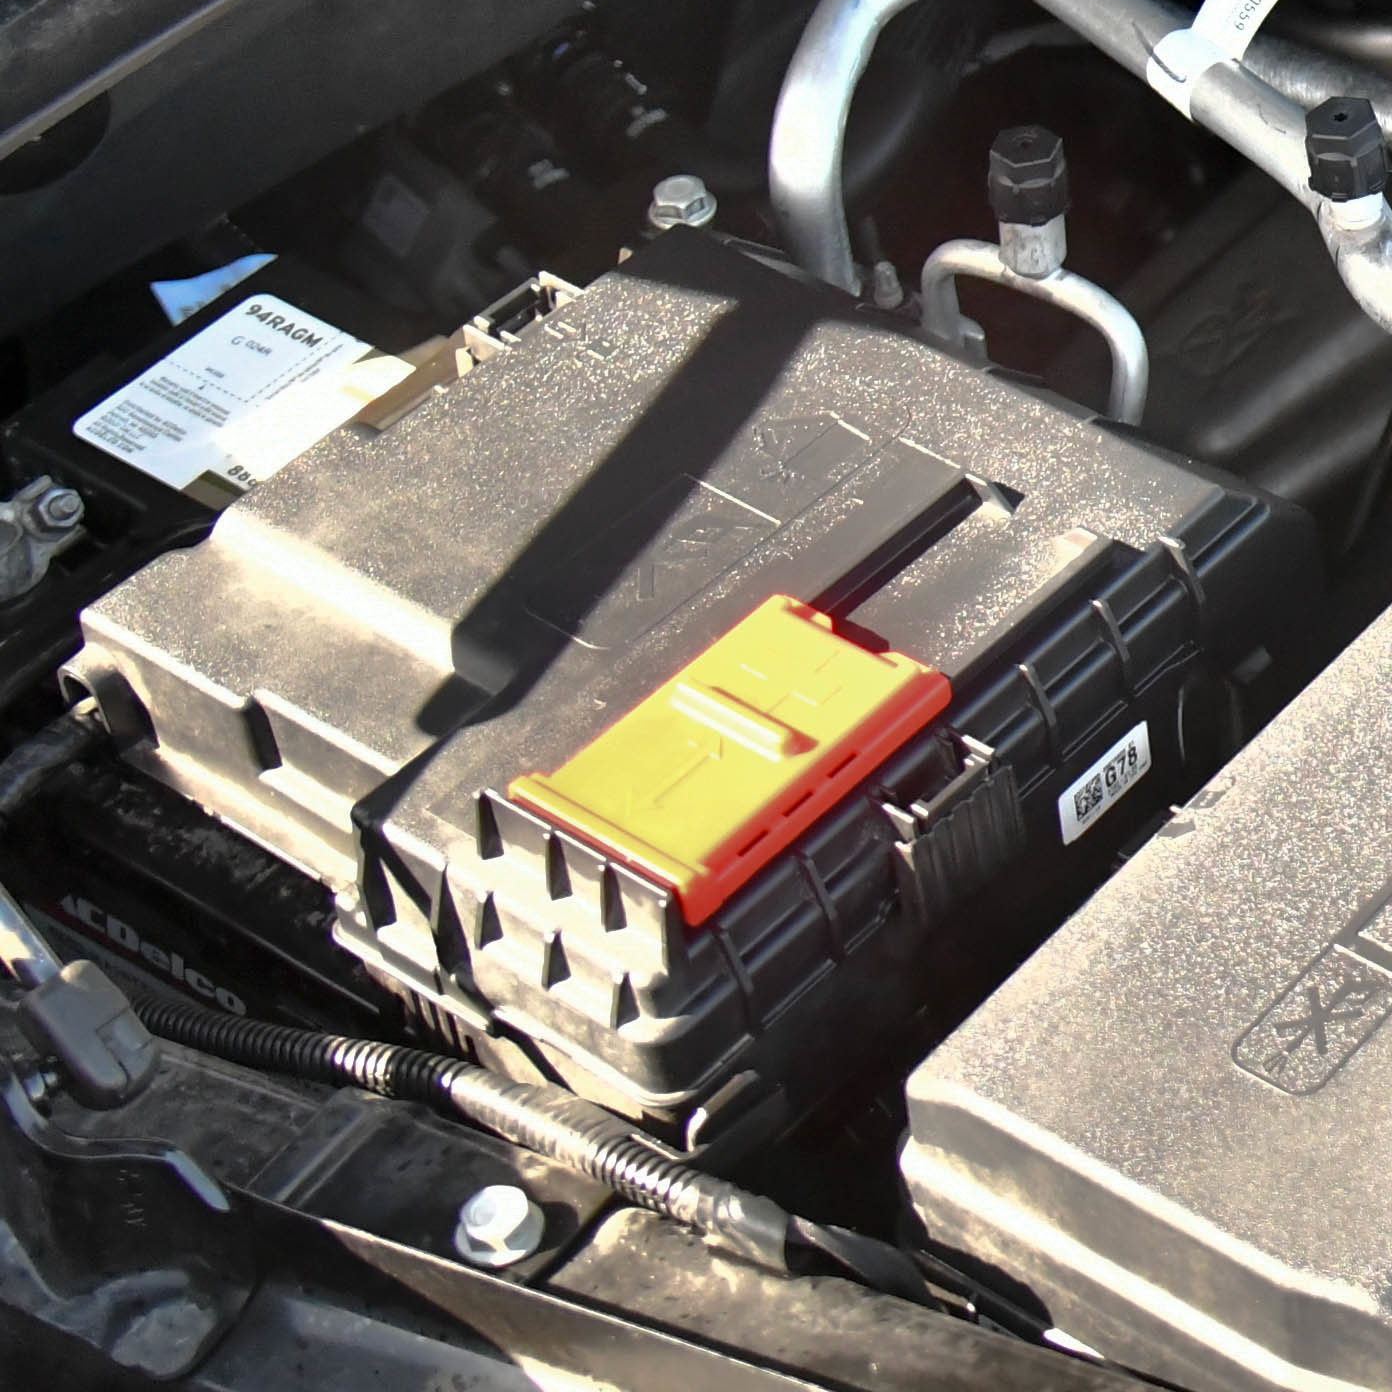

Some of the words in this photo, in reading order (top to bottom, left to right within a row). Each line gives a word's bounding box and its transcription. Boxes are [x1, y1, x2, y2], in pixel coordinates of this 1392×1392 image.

[244, 303, 325, 349] 94RAGM
[1104, 746, 1138, 788] G78
[59, 893, 247, 1016] ACDelco
